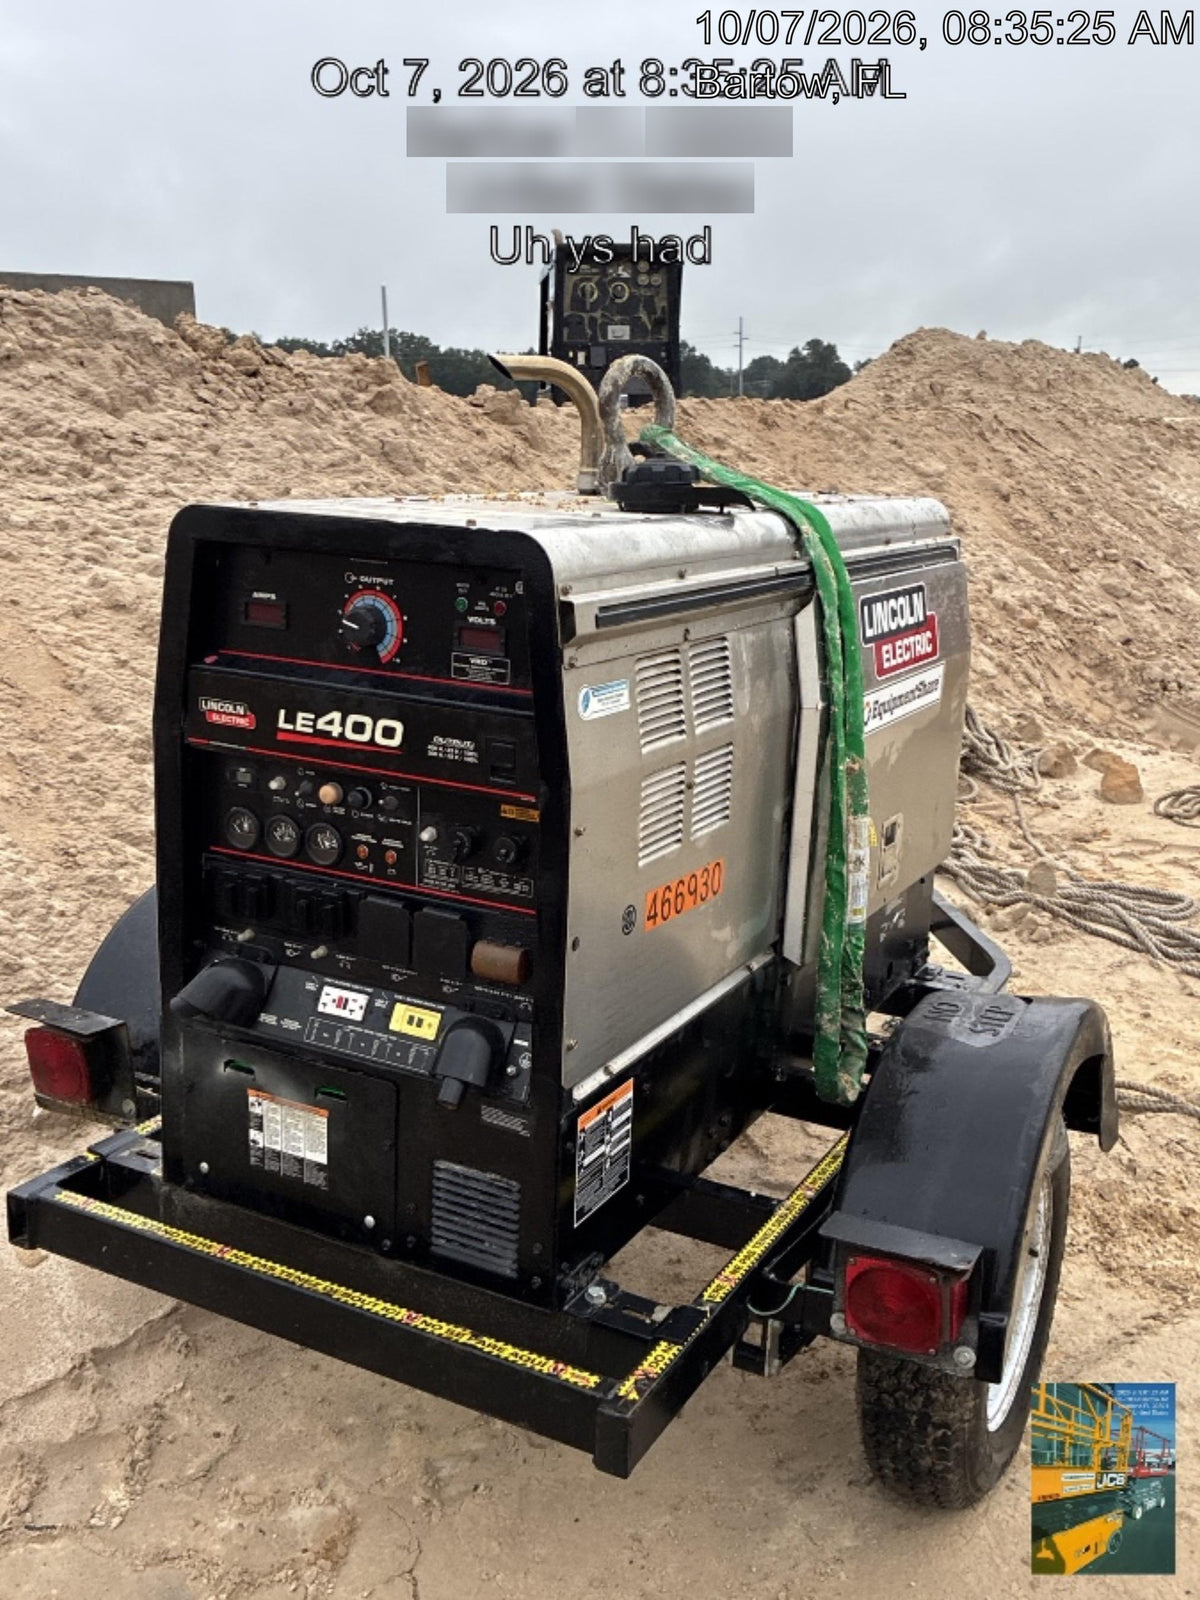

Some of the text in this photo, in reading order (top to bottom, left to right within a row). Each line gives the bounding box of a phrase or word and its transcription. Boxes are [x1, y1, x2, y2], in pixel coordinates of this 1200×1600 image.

[359, 575, 395, 586] OUTPUT
[467, 615, 496, 626] VOLTS
[863, 591, 925, 638] LINCOLN
[881, 630, 933, 669] ELECTRIC
[201, 700, 245, 715] LINCOLN
[872, 678, 940, 721] EquipmentShare
[277, 708, 404, 748] LE400
[646, 861, 722, 926] 466930
